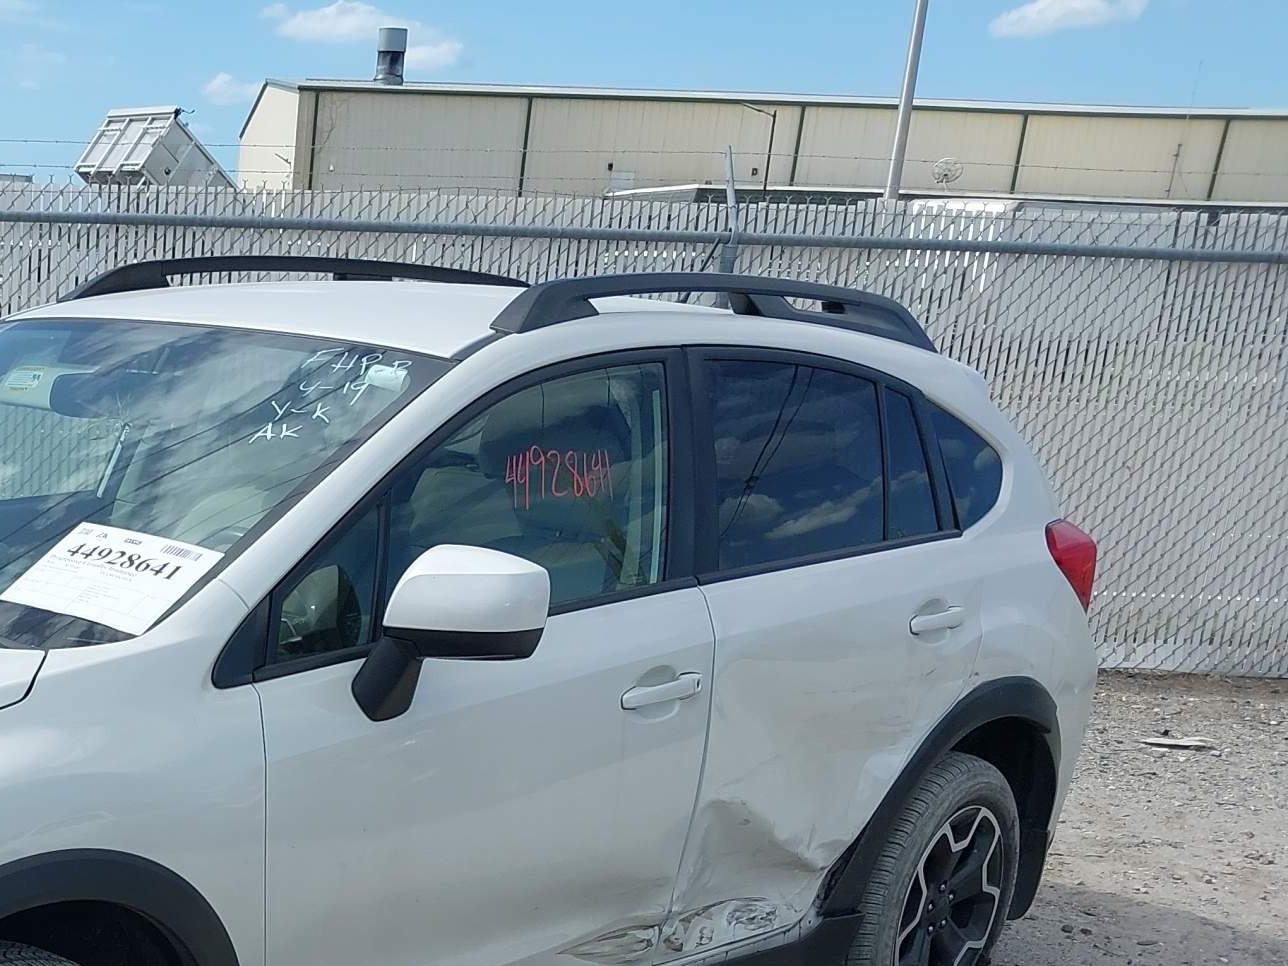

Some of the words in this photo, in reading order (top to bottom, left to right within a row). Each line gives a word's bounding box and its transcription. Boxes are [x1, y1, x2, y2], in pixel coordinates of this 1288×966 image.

[248, 421, 304, 444] AK
[504, 445, 614, 511] 44928641
[67, 542, 183, 581] 44928641
